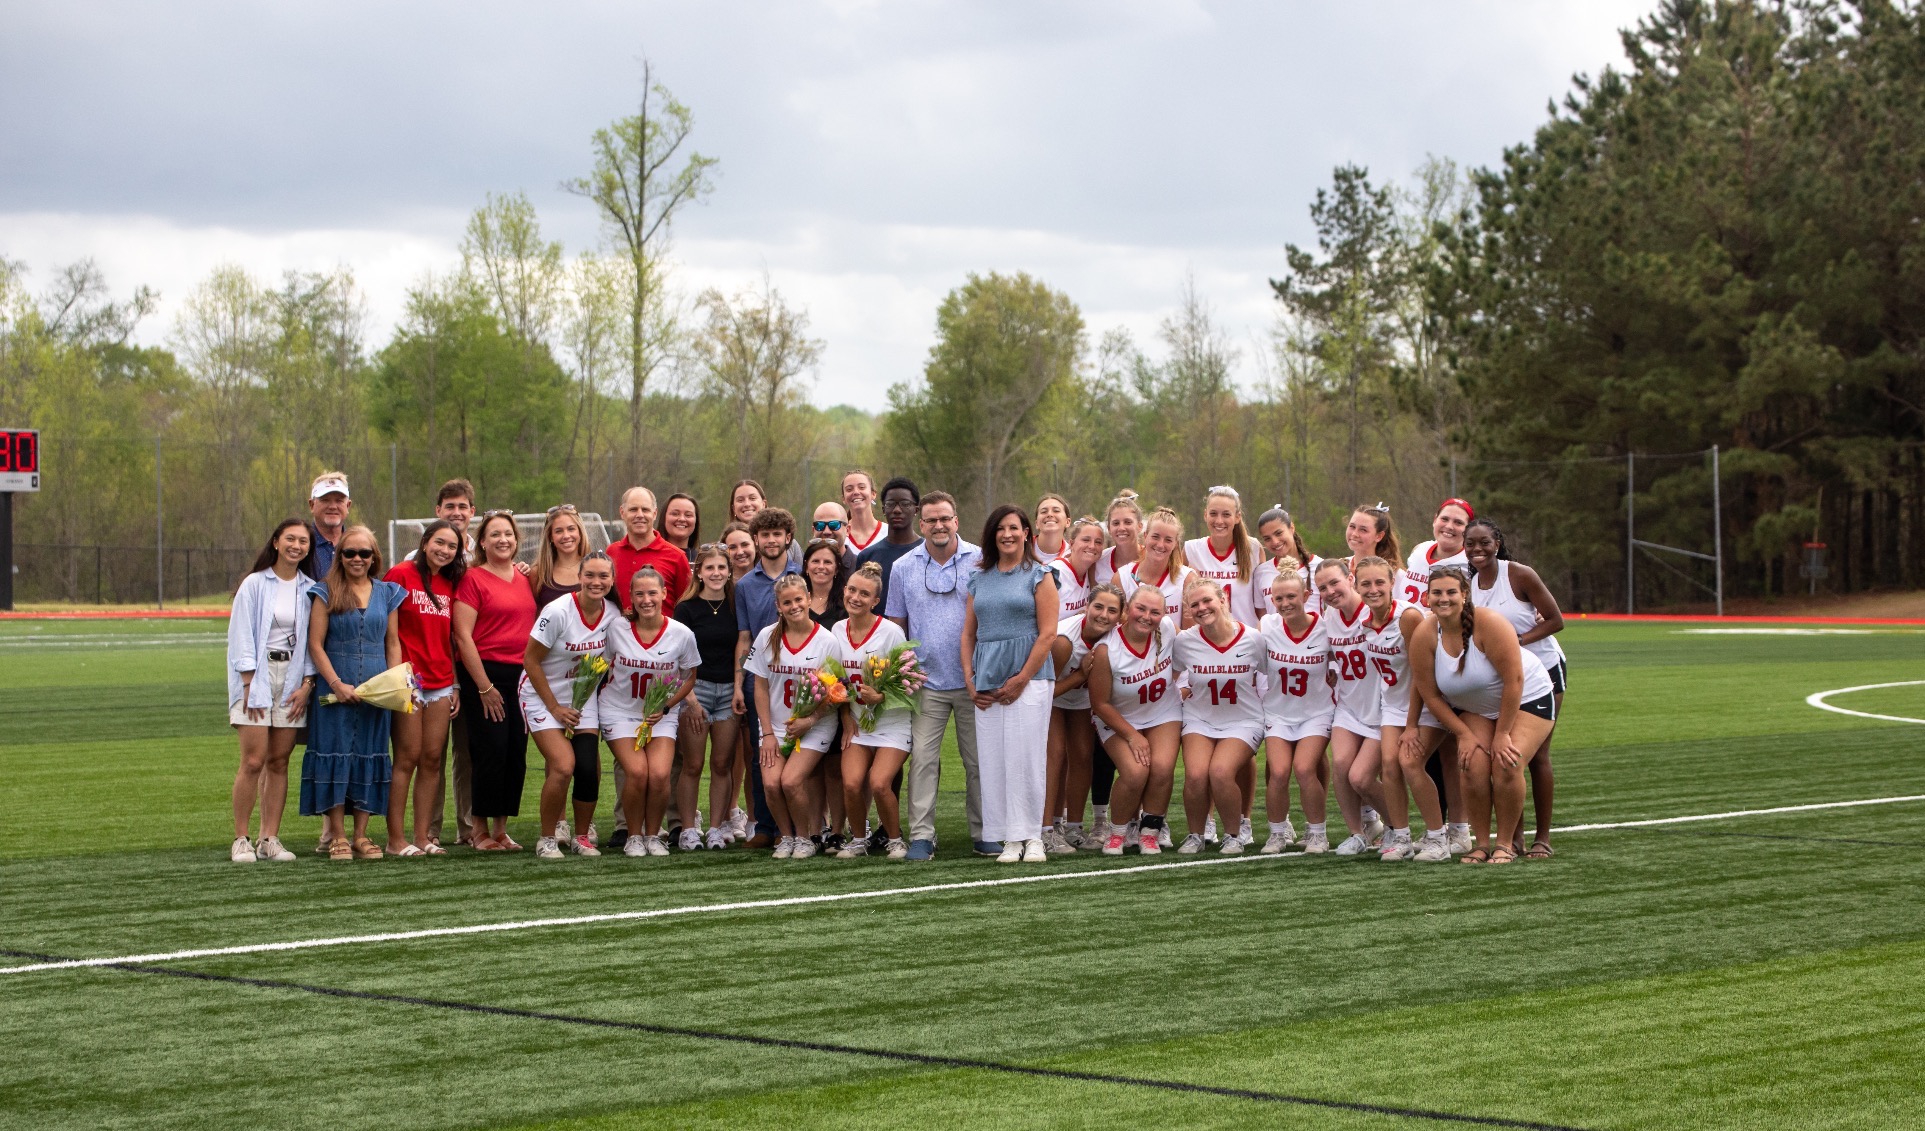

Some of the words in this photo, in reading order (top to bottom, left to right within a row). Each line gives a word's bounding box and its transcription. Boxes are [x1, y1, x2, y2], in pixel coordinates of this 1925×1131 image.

[620, 655, 675, 671] TRAILBLAZERS
[1193, 664, 1250, 675] TRAILBLAZERS
[1267, 648, 1325, 665] TRAILBLAZERS
[1335, 649, 1368, 680] 28
[1278, 667, 1309, 697] 13
[1371, 656, 1398, 687] 15
[1137, 677, 1167, 705] 18
[1207, 678, 1238, 706] 14
